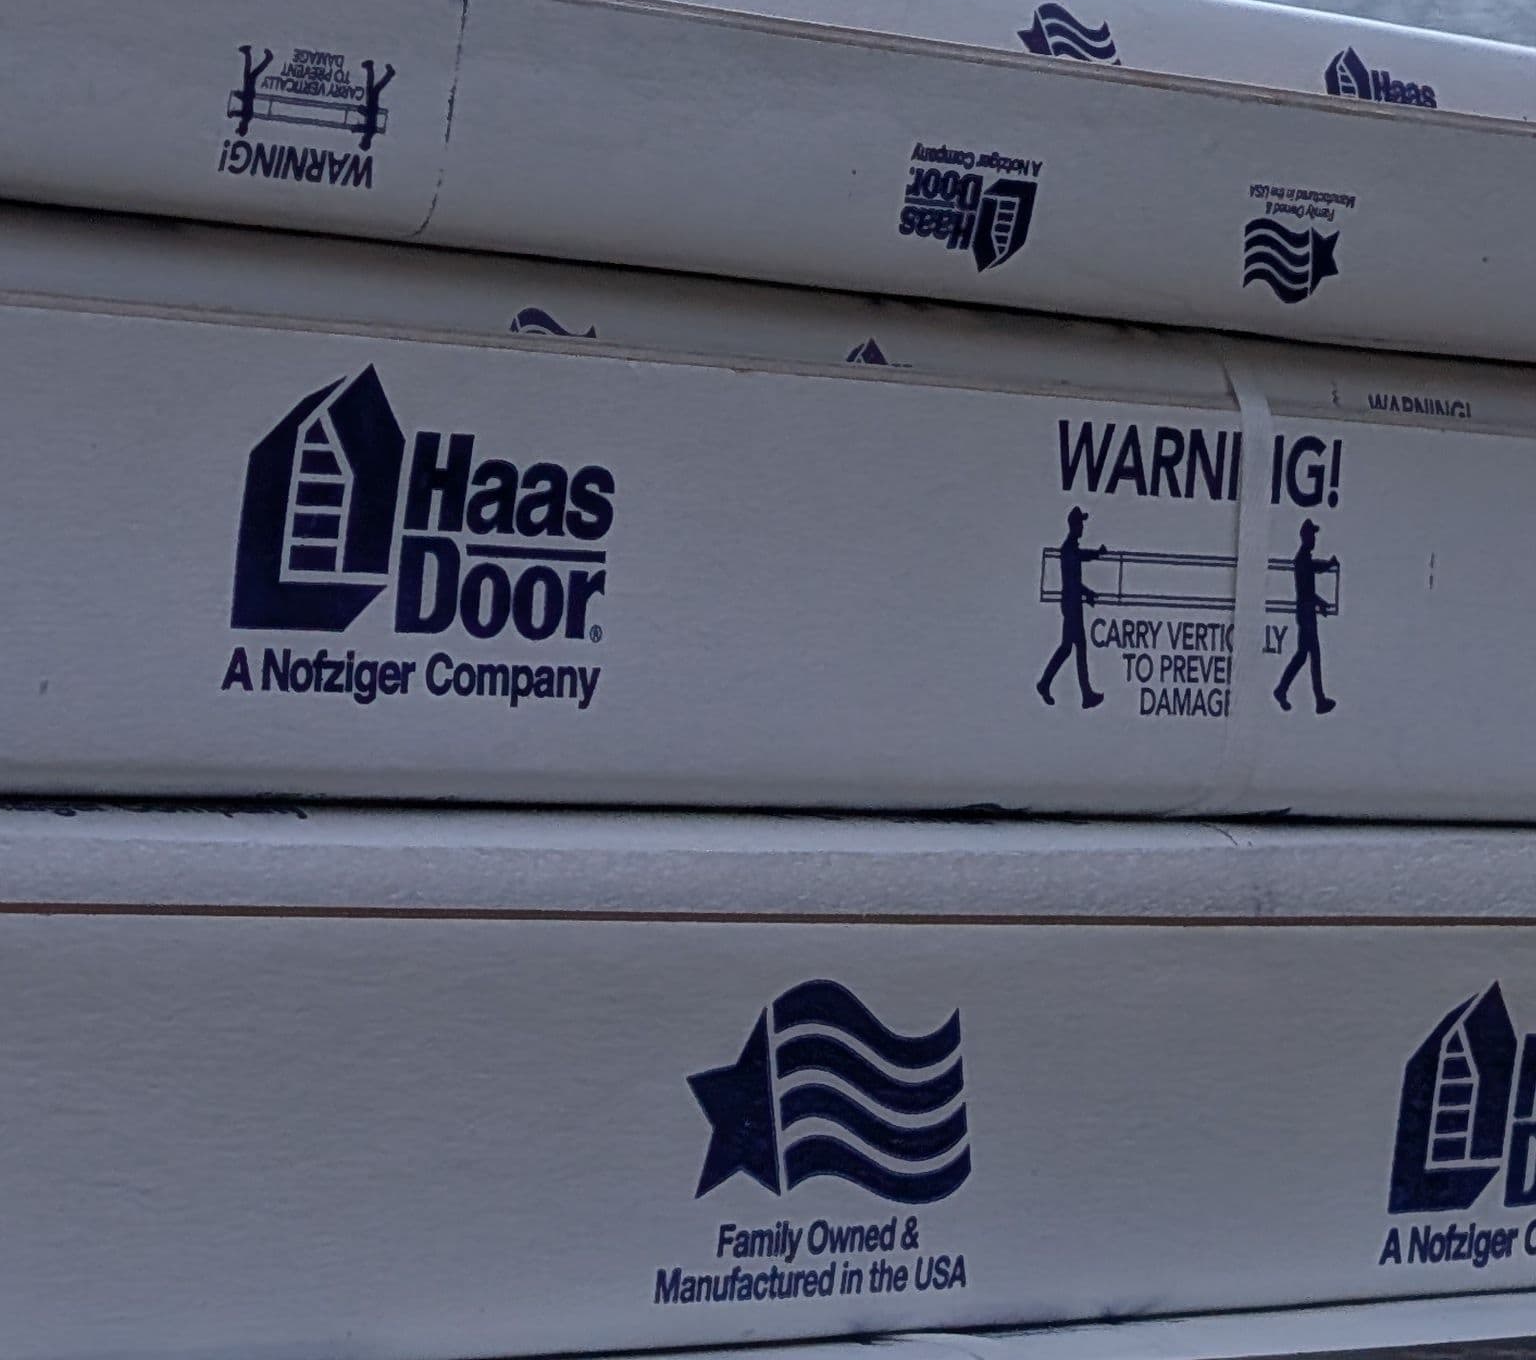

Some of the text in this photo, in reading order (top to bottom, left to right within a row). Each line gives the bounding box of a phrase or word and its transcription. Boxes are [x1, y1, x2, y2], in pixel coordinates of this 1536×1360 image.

[280, 62, 351, 85] TO PREVENT
[293, 48, 344, 68] DAMAGE
[261, 76, 365, 101] CARRY VERTICALLY
[218, 139, 374, 189] WARNING!
[899, 205, 977, 250] Haas
[402, 430, 616, 541] Haas
[1090, 617, 1163, 650] CARRY
[221, 646, 602, 710] A Nofziger Company
[1122, 652, 1233, 685] TO PREVE
[716, 1215, 920, 1263] Family Owned &
[1378, 1226, 1402, 1266] A
[1407, 1222, 1519, 1269] Nofziger
[653, 1254, 967, 1305] Manufactured in the USA
